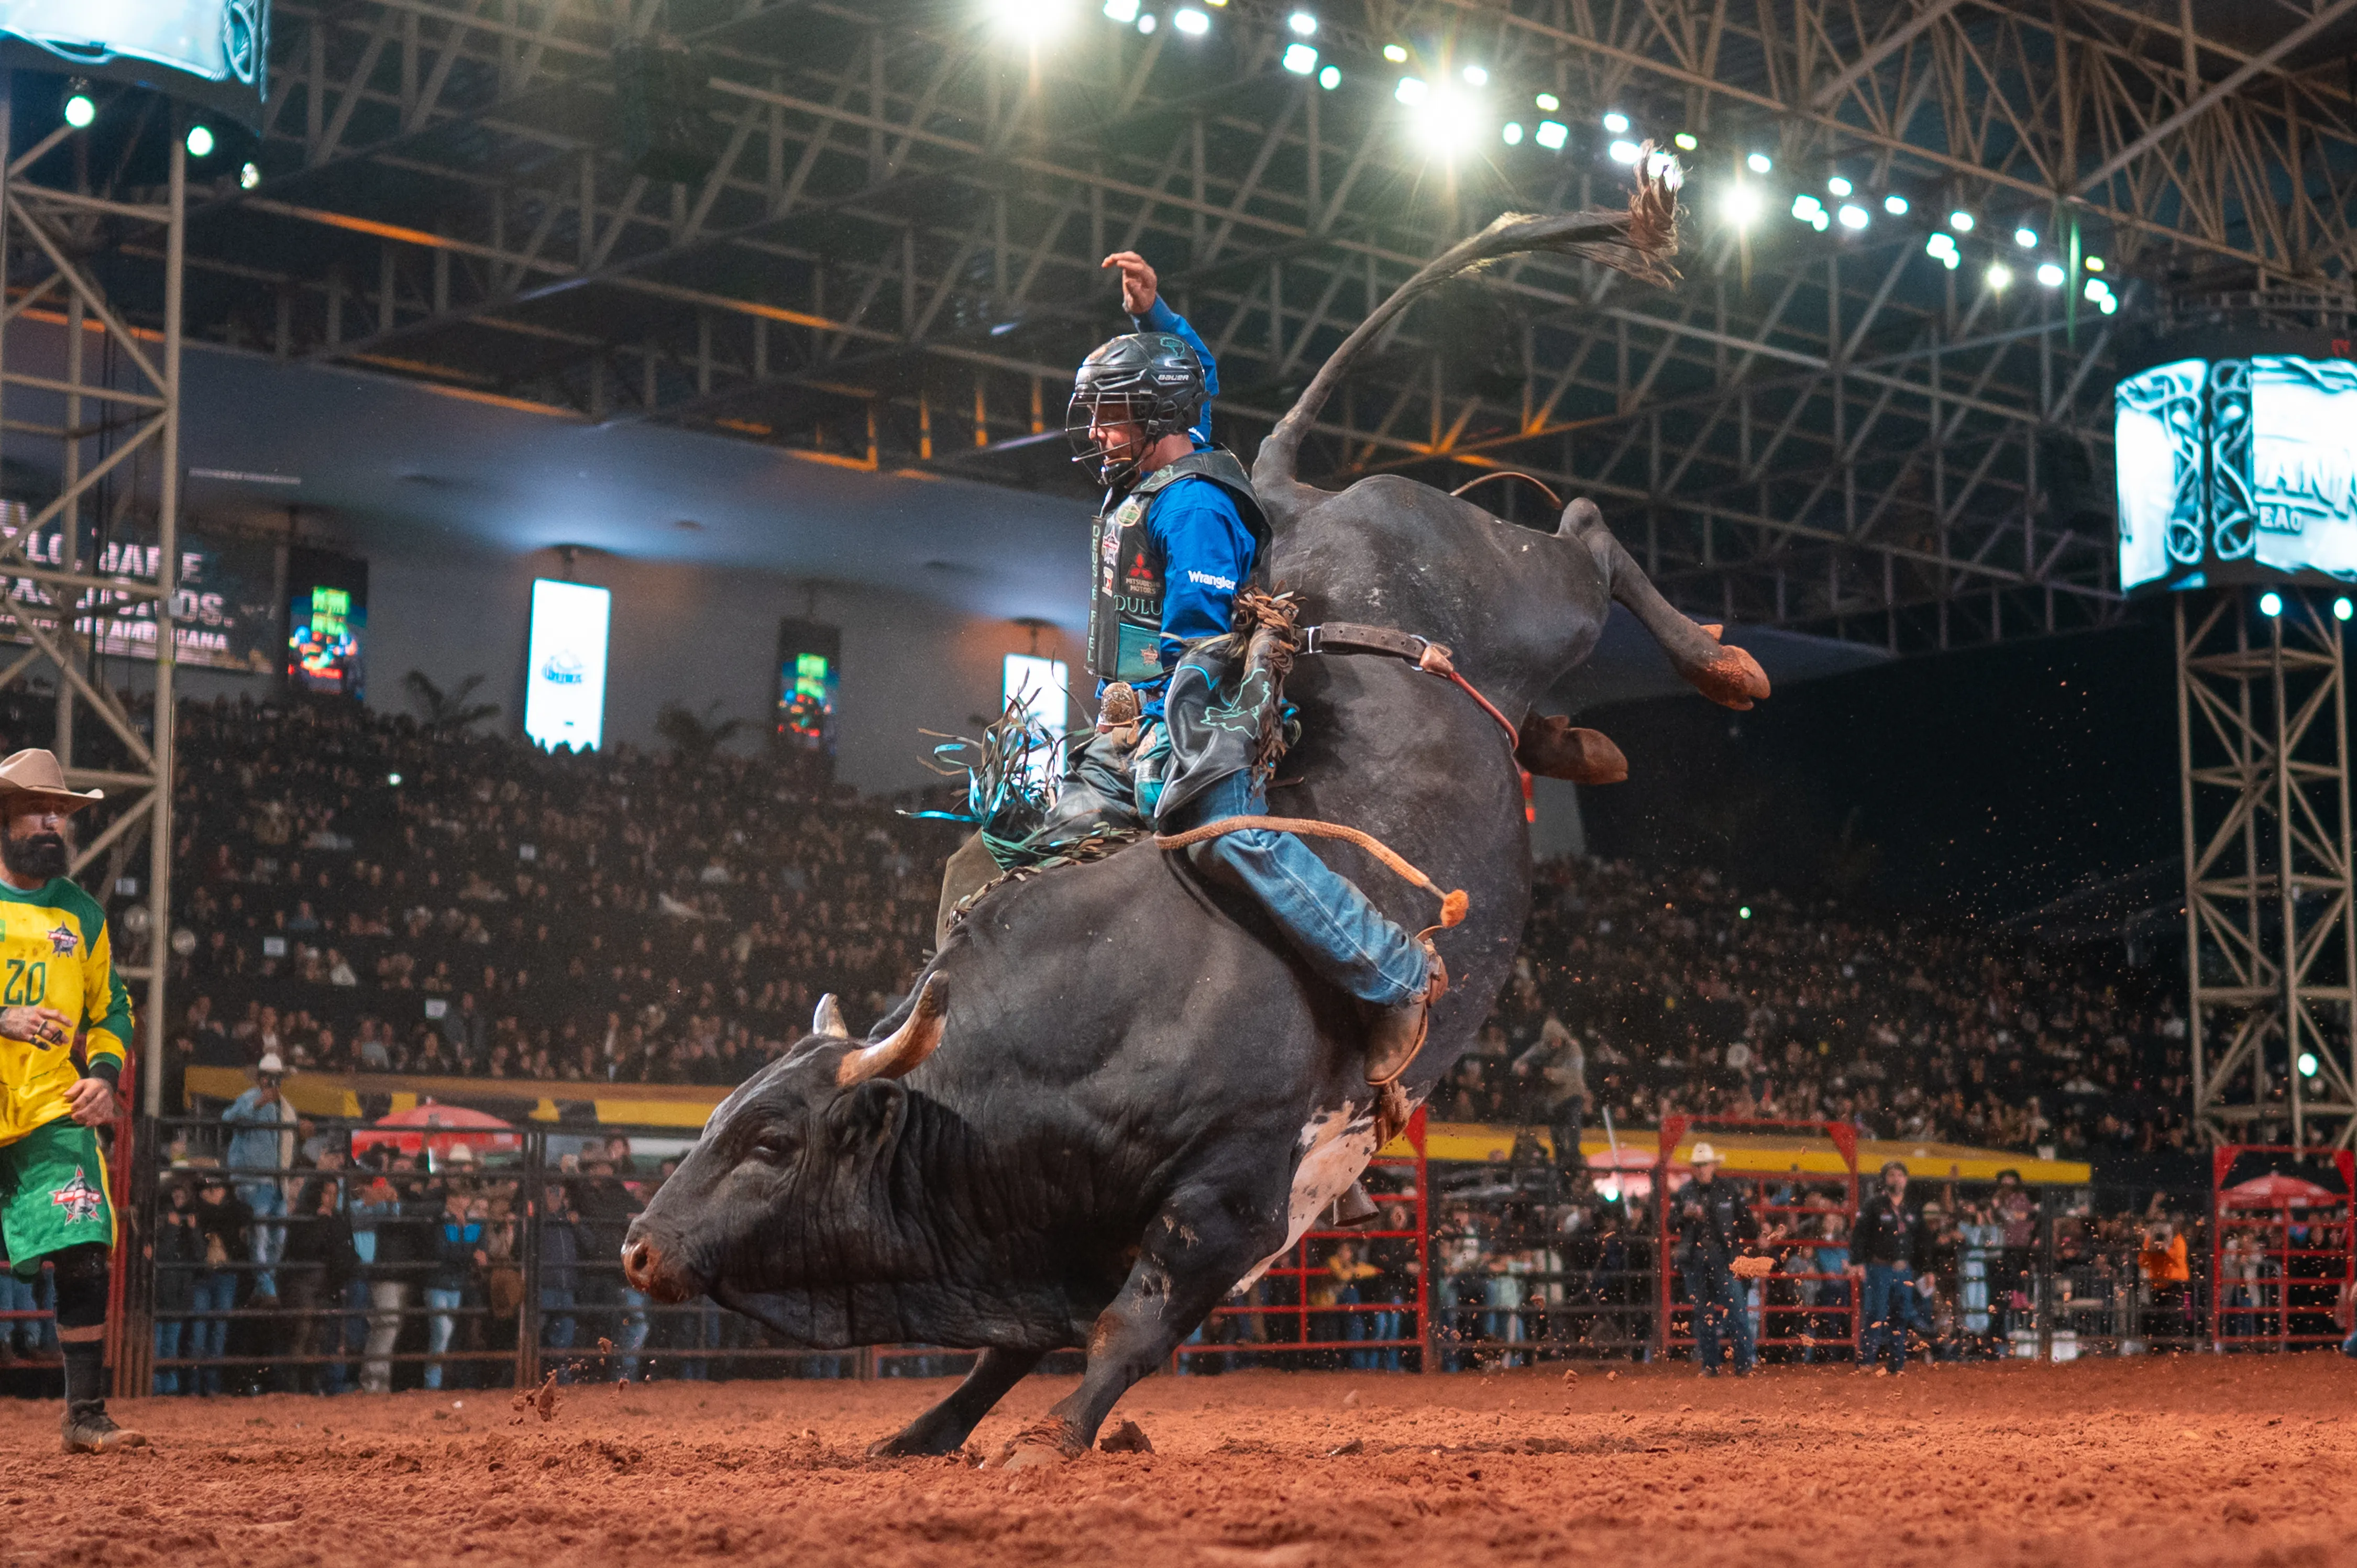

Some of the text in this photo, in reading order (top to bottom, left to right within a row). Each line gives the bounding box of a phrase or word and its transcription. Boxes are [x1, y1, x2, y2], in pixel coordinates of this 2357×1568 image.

[1092, 525, 1100, 577] DEUS
[1126, 578, 1161, 588] MITSUBISHI
[1130, 584, 1157, 594] MOTORS
[1187, 570, 1236, 590] Wrangler
[1087, 610, 1097, 662] FIEL
[4, 959, 46, 1006] 20
